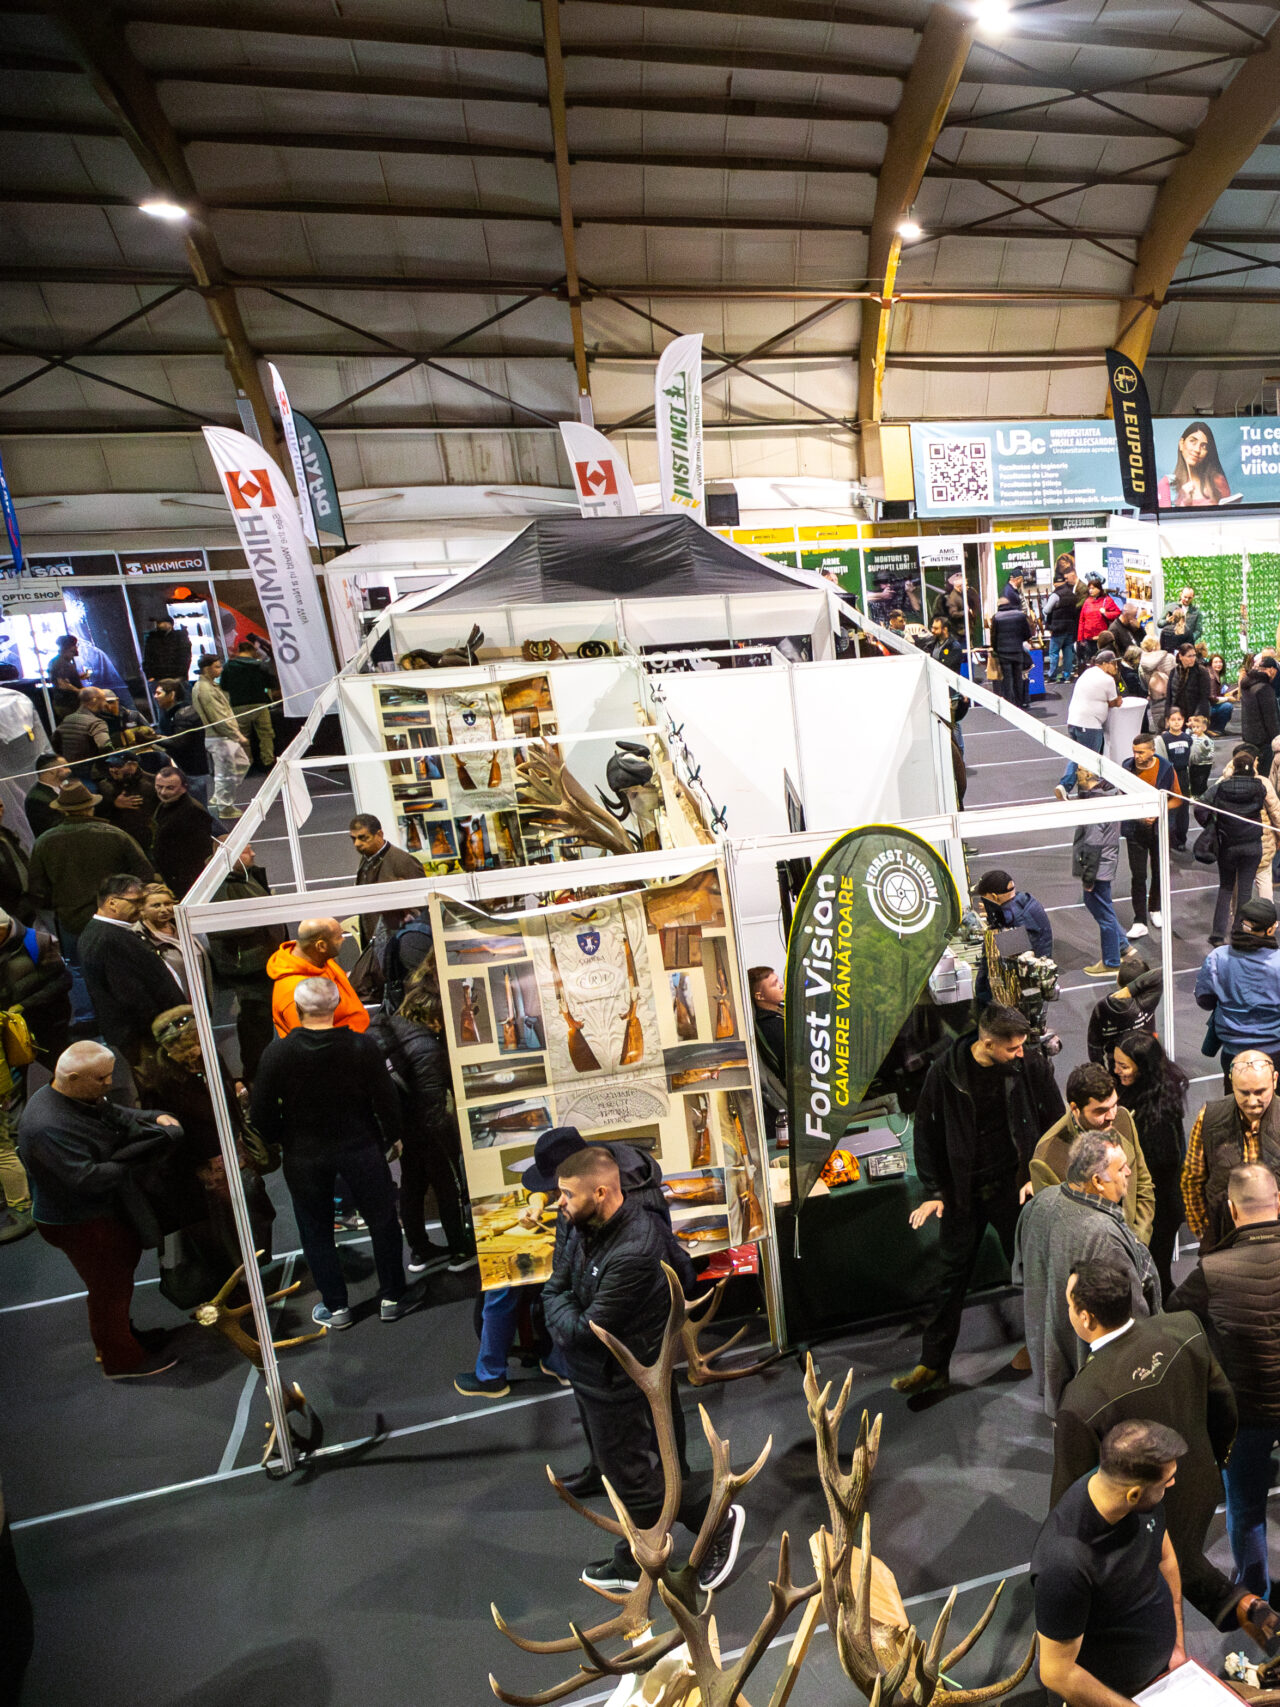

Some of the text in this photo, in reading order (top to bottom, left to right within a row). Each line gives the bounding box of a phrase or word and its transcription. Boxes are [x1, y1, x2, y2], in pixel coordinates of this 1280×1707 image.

[669, 402, 693, 499] INSTINCT
[1122, 400, 1146, 493] LEUPOLD
[1240, 426, 1261, 440] Tu
[145, 558, 203, 573] HIKMICRO
[823, 557, 841, 566] ARME
[2, 591, 60, 601] OPTIC SHOP
[866, 849, 939, 898] FOREST VISION
[803, 874, 836, 1141] Forest Vision
[833, 874, 855, 1107] CAMERE VÂNĂTOARE
